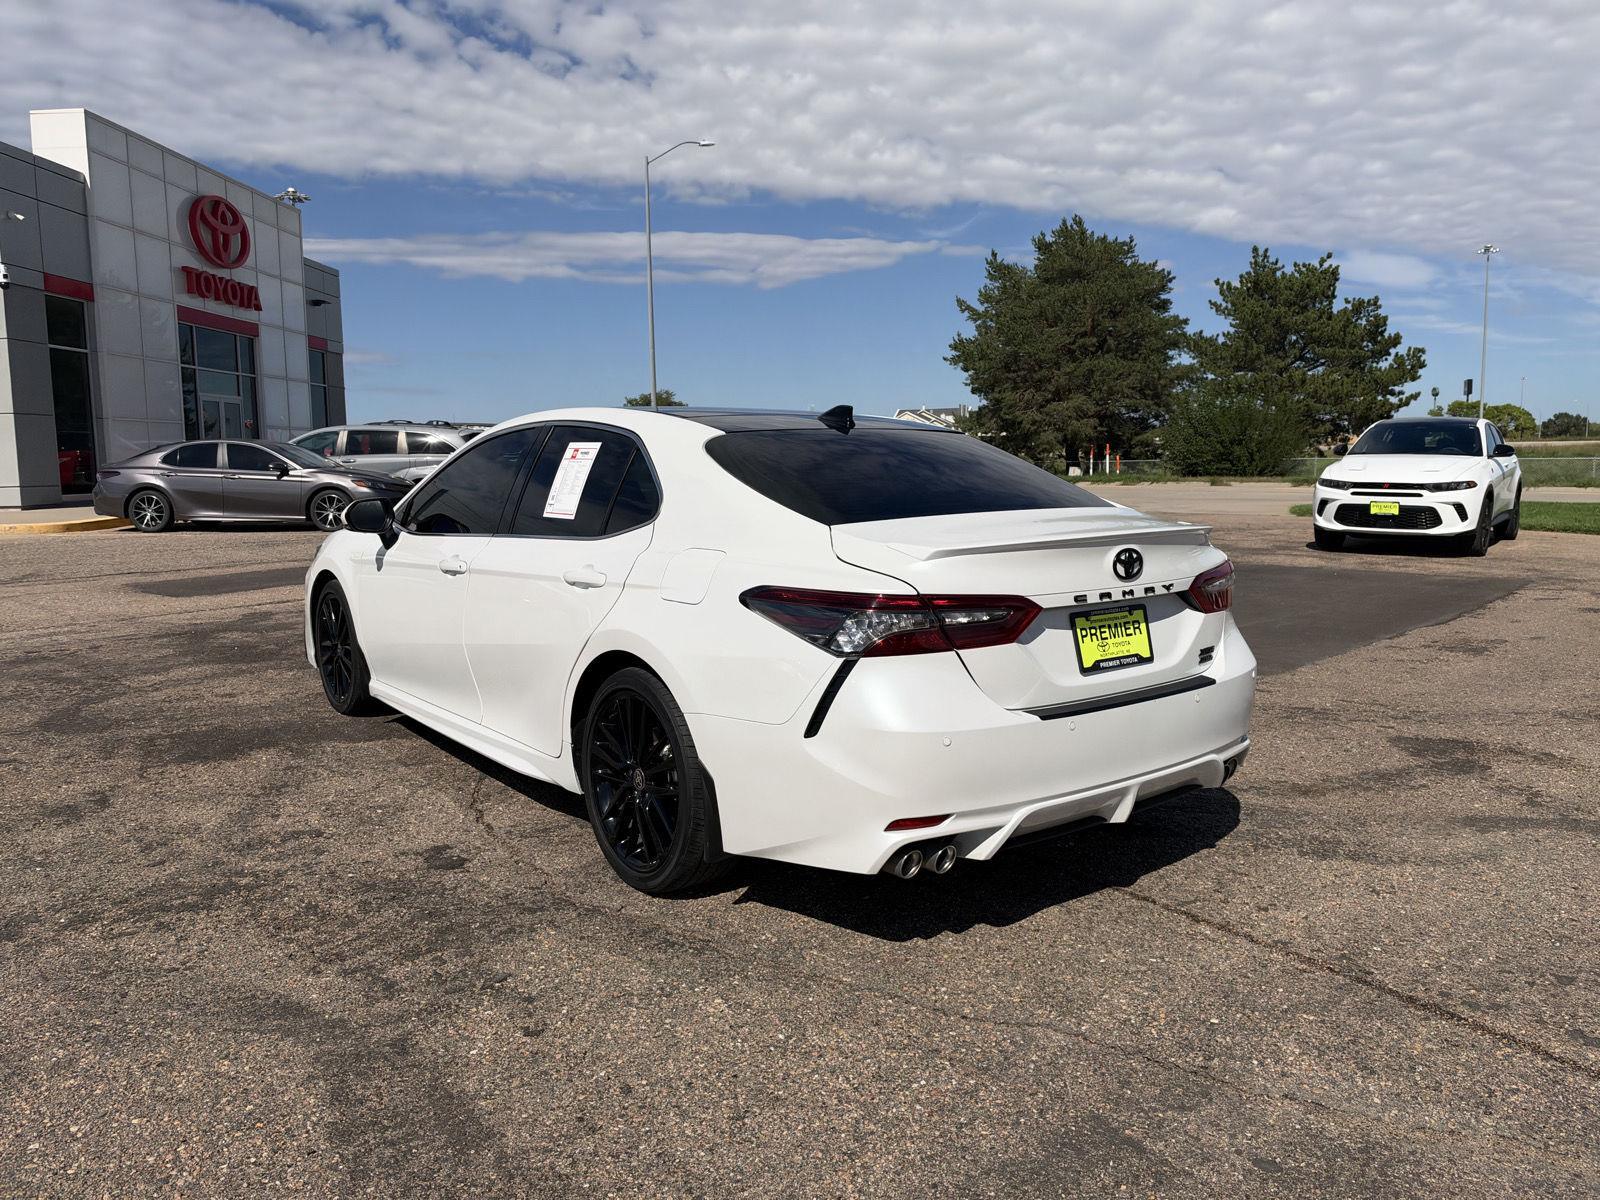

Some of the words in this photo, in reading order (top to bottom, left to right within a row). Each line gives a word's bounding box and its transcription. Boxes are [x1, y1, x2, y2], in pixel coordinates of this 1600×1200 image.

[181, 266, 262, 311] TOYOTA
[1074, 583, 1174, 604] CAMRY
[1080, 620, 1142, 644] PREMIER
[1112, 640, 1131, 648] TOYOTA
[1100, 659, 1120, 668] PREMIER
[1121, 657, 1138, 665] TOYOTA
